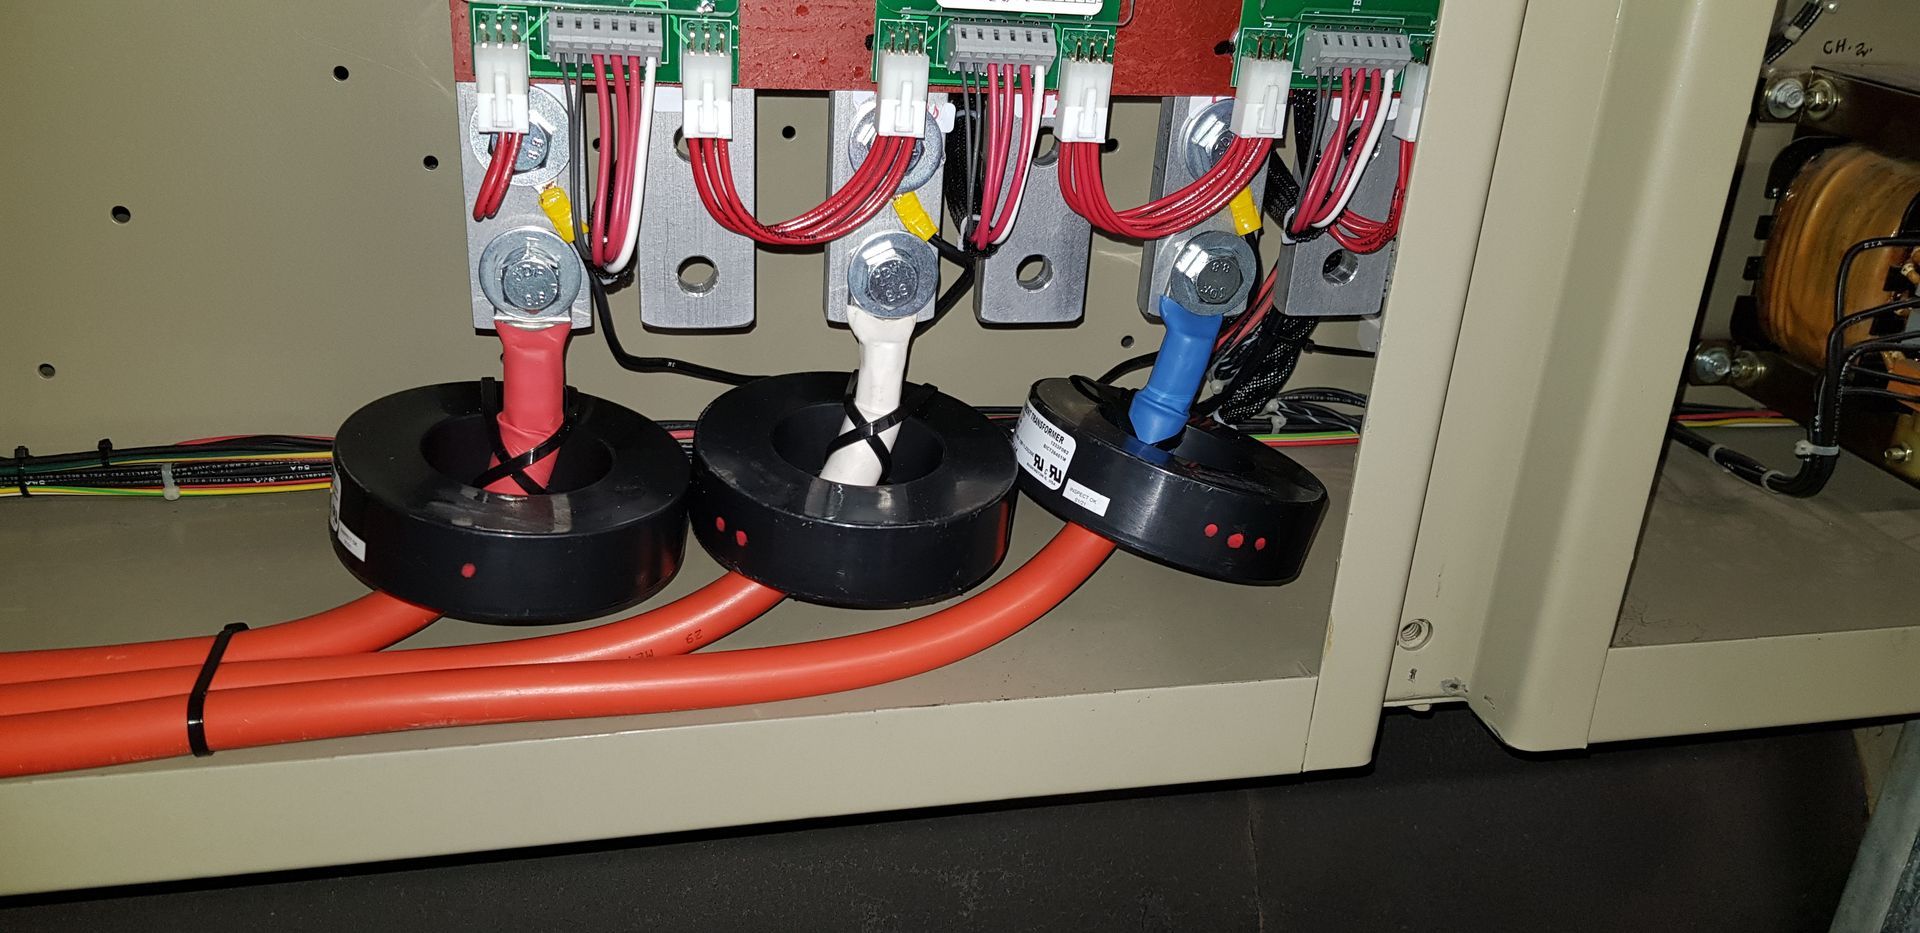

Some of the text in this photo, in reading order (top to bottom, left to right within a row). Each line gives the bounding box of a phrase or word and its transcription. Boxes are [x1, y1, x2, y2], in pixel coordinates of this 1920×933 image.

[1263, 15, 1275, 28] J1
[1030, 412, 1065, 445] TRANSFORMER
[1069, 487, 1090, 500] INSPECT
